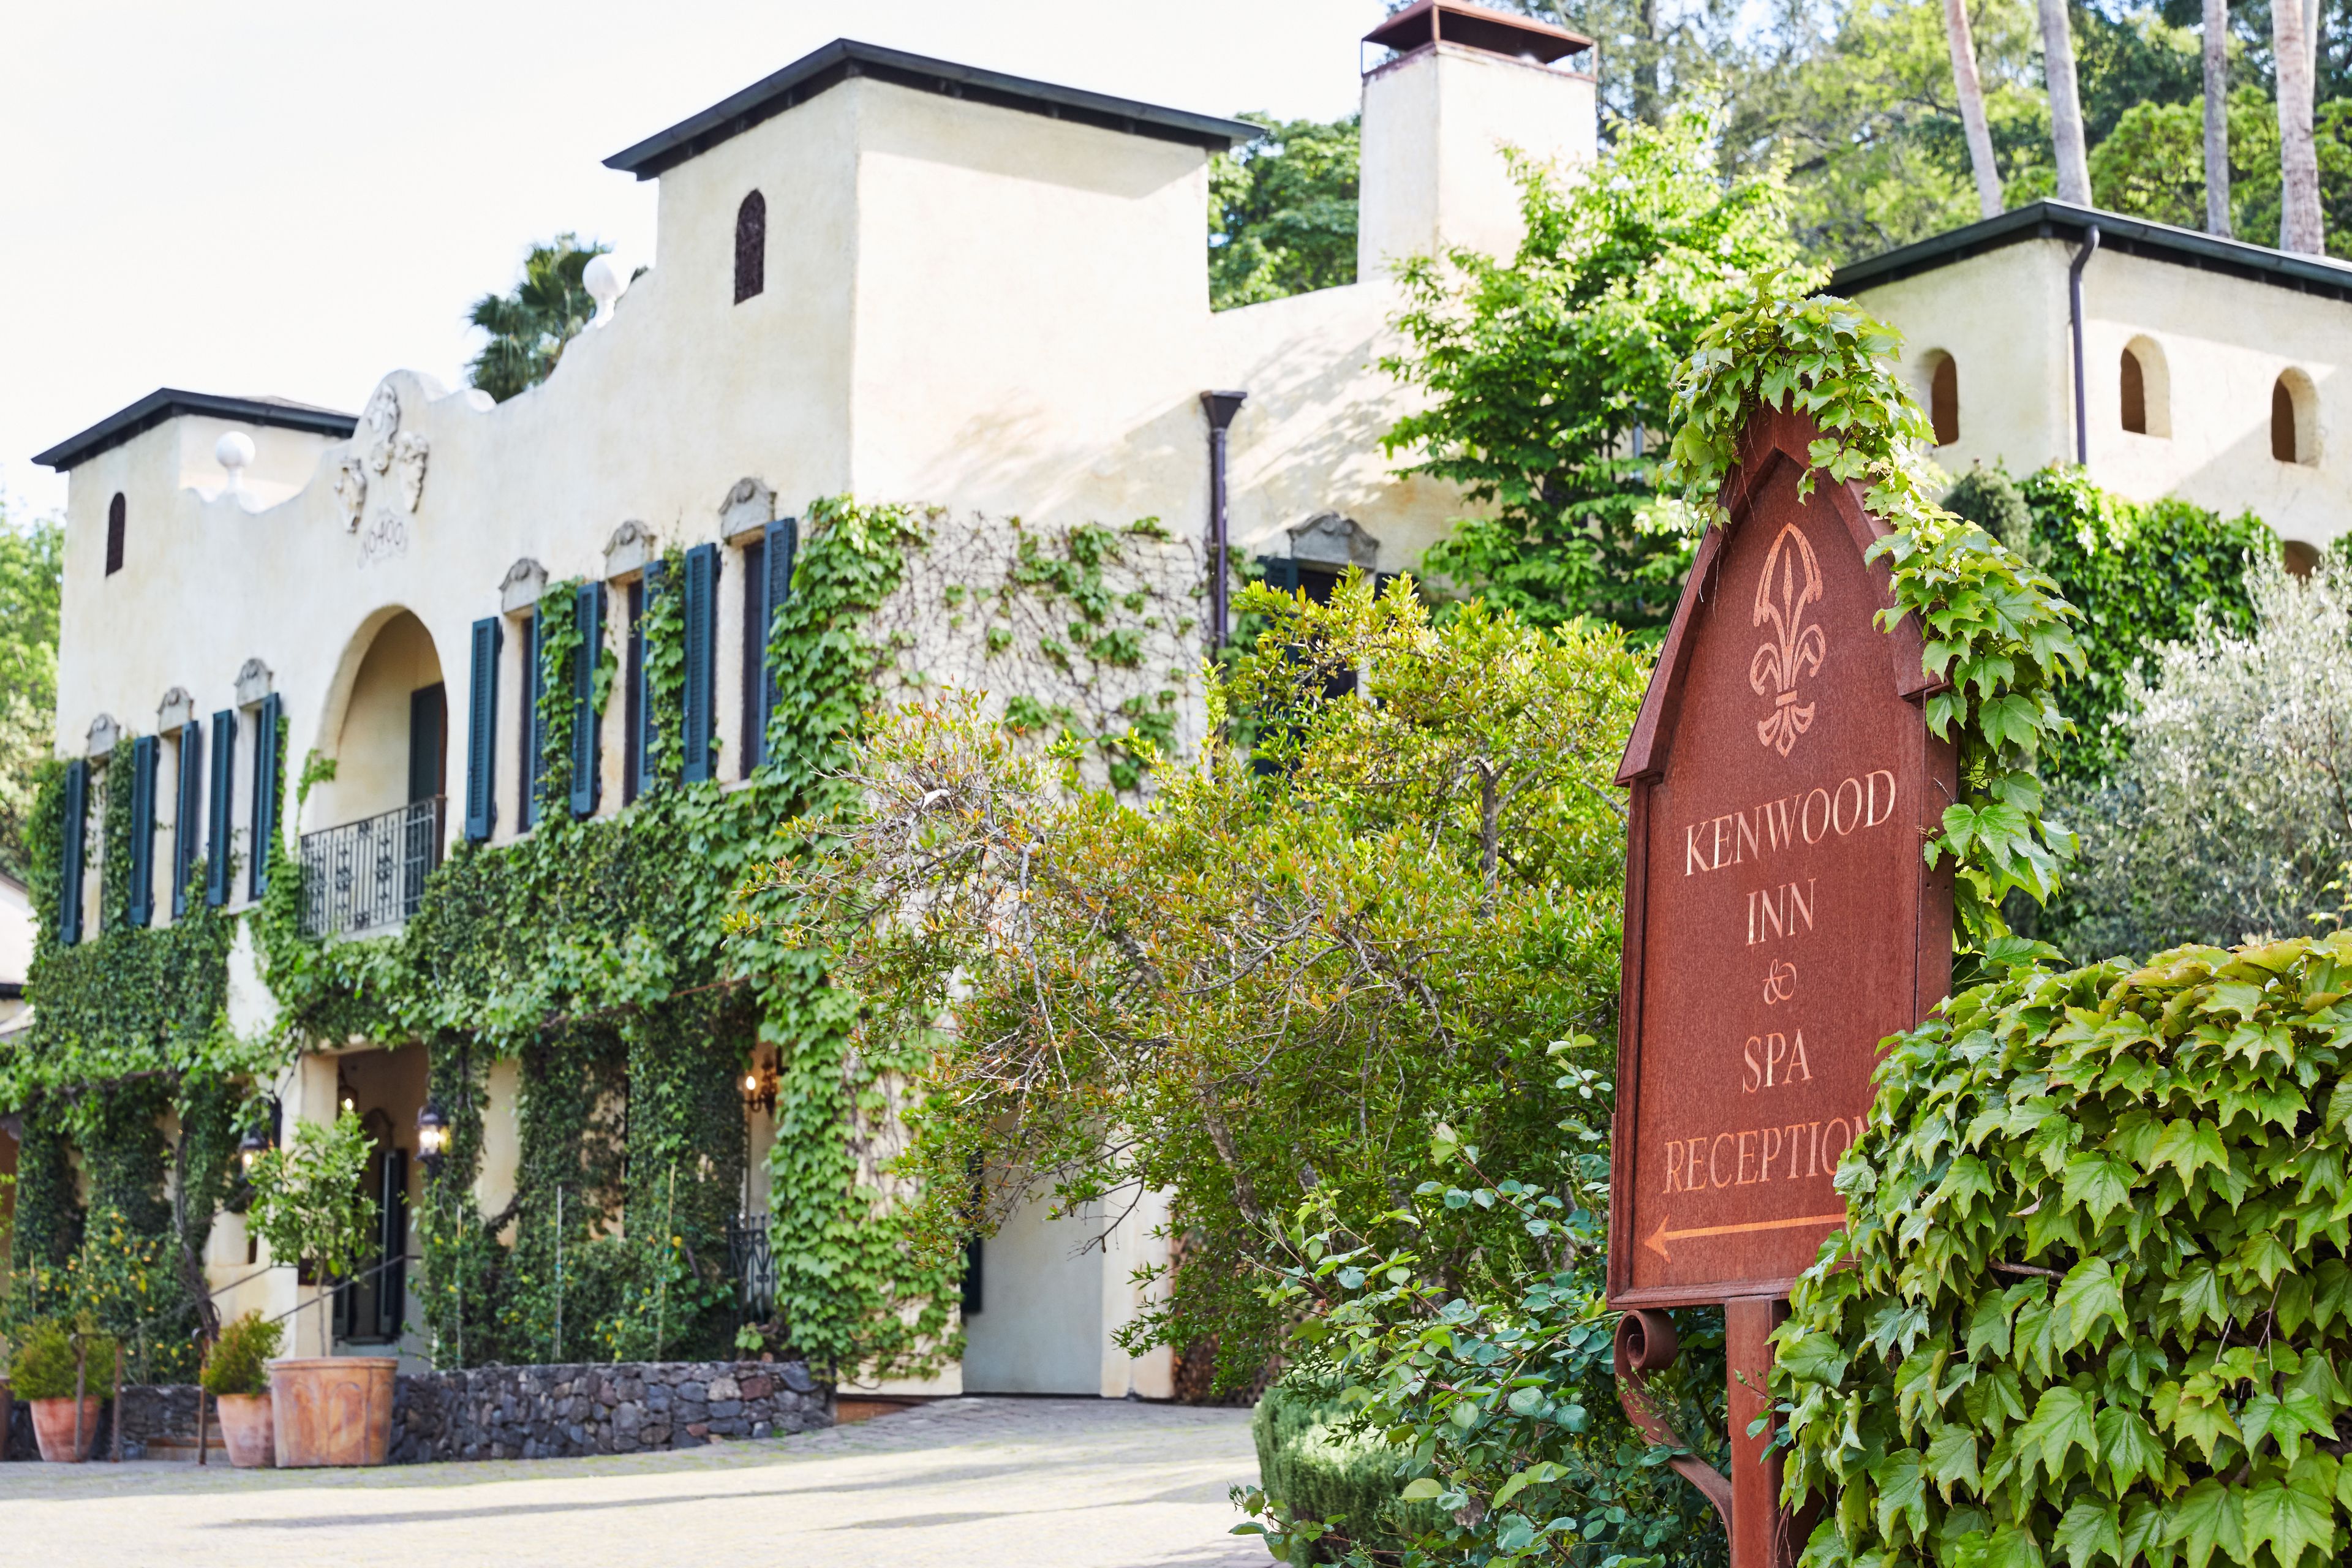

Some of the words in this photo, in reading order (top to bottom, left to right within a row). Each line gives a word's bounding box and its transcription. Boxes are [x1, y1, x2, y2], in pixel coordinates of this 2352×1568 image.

[1683, 769, 1896, 876] KENWOOD
[1746, 878, 1817, 946] INN
[1762, 959, 1797, 1005] &
[1742, 1028, 1813, 1094] SPA
[1662, 1115, 1869, 1194] RECEPTIO
